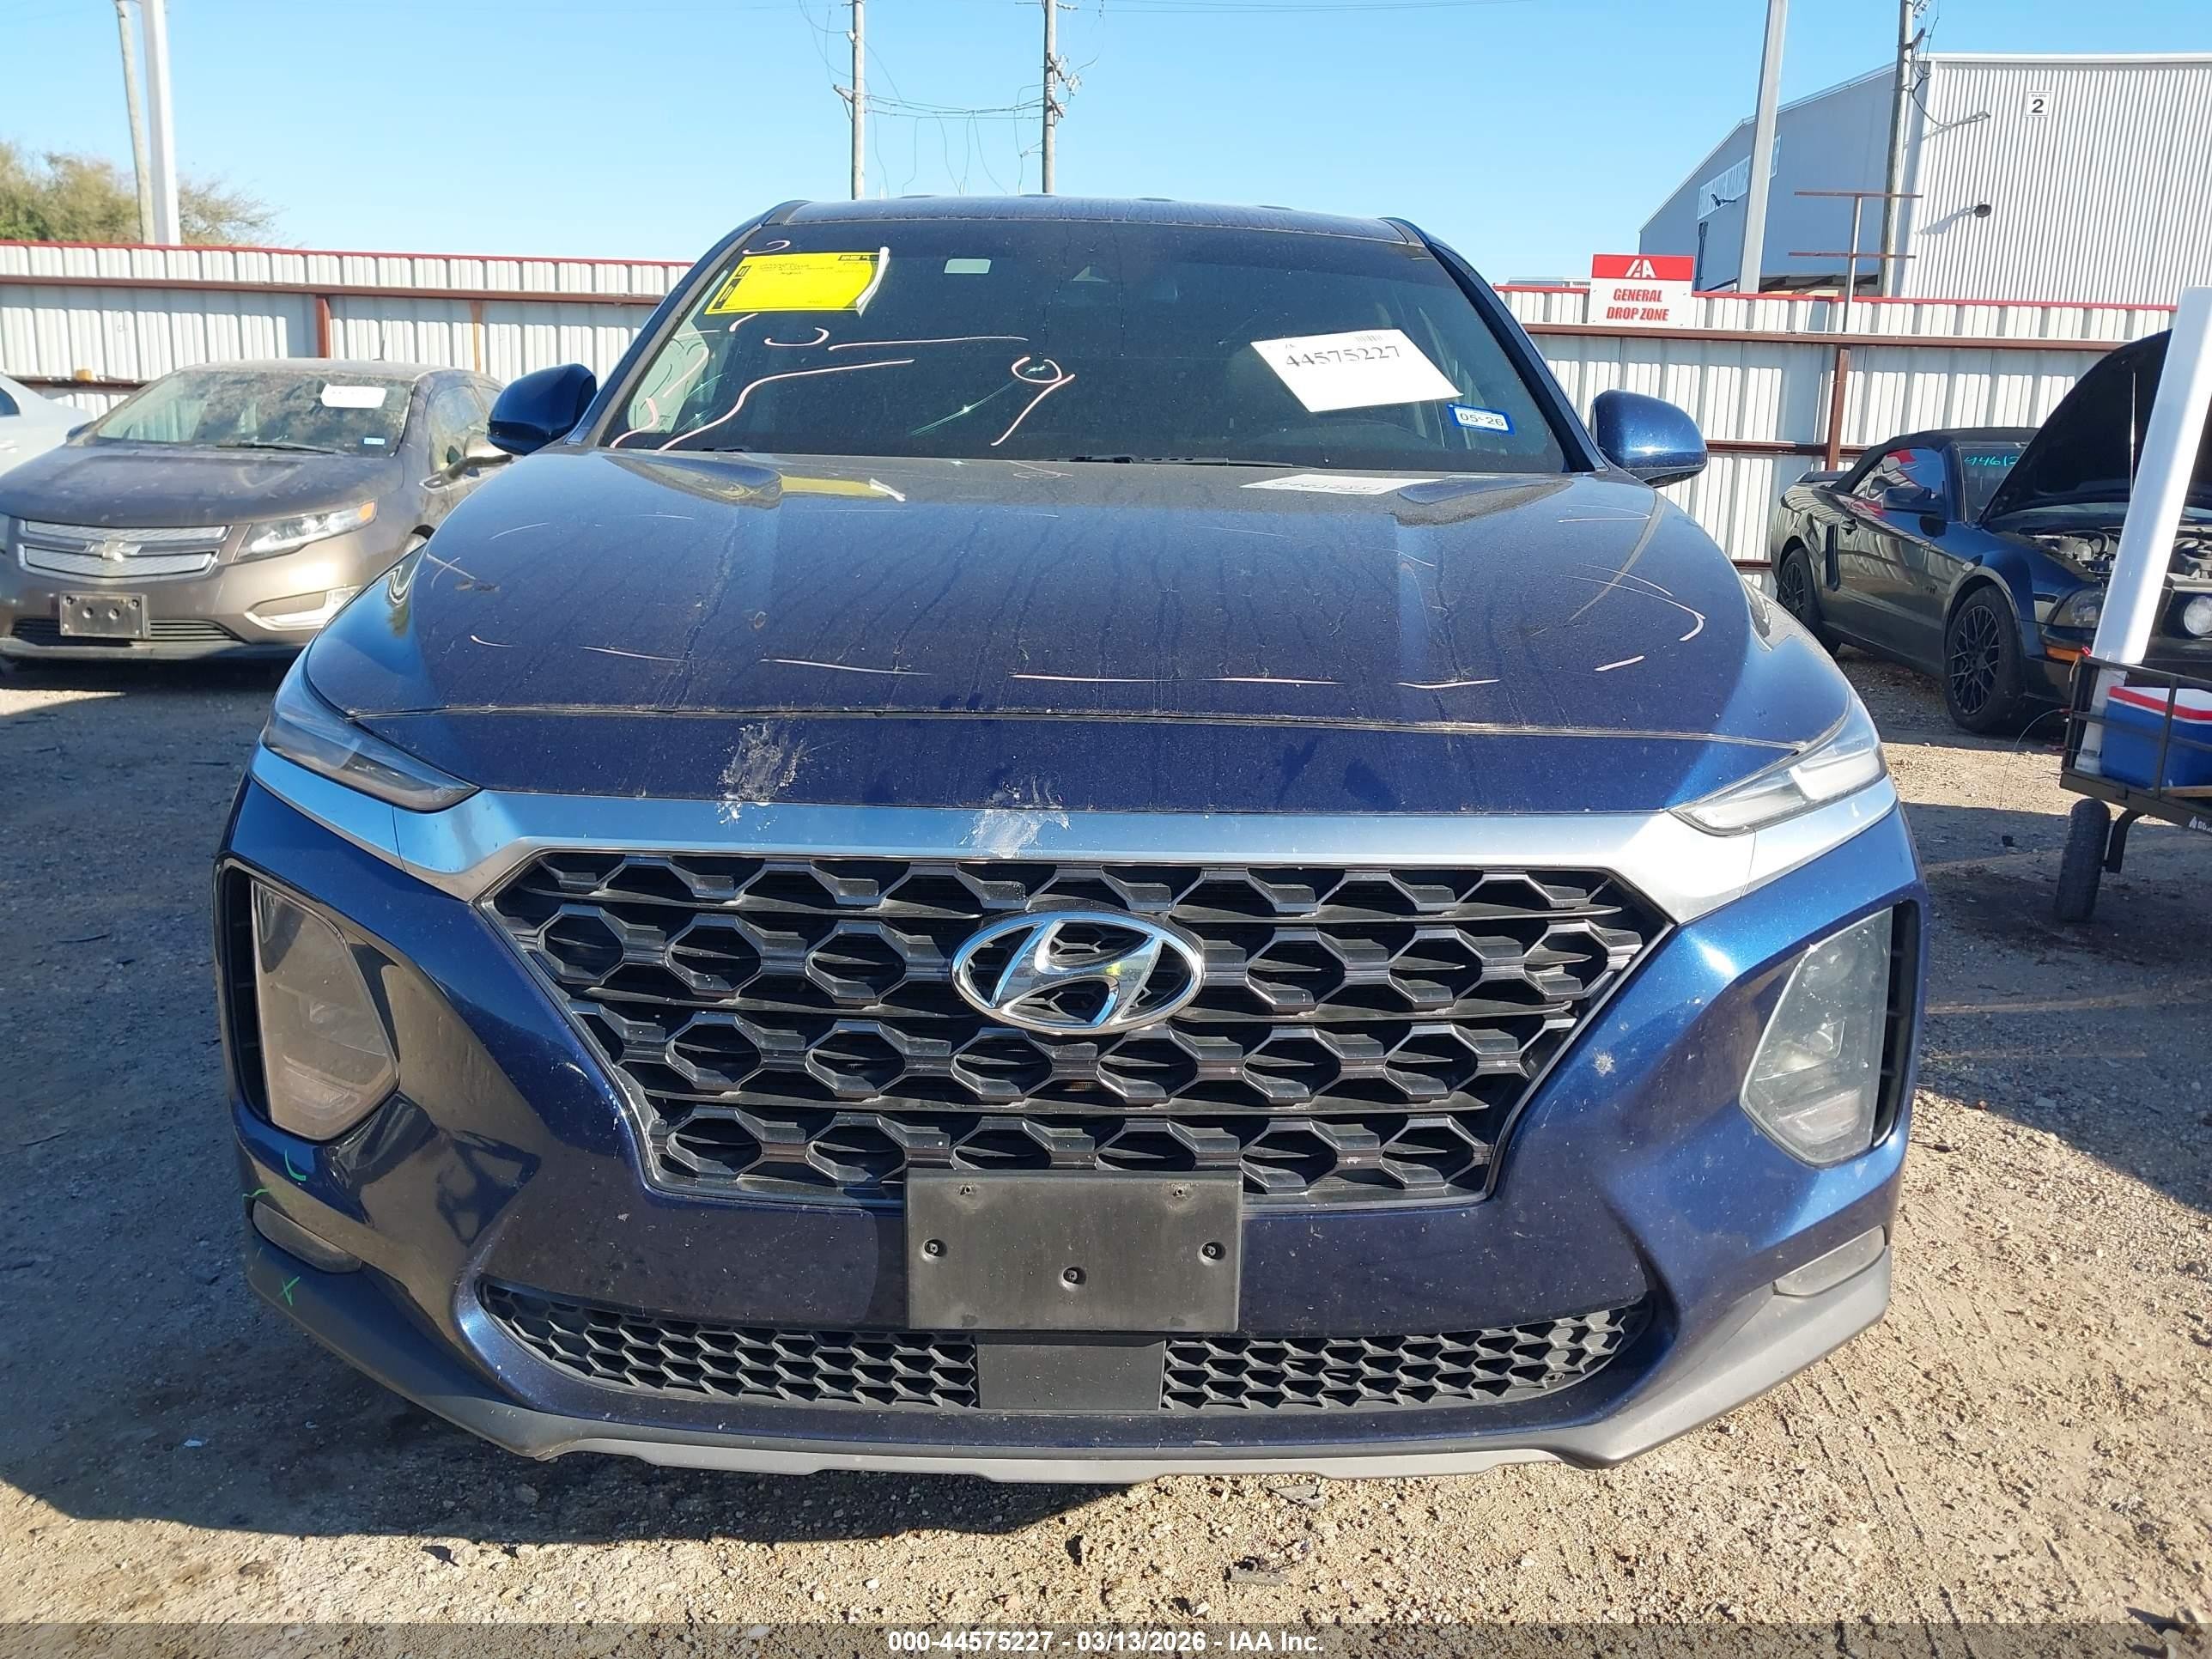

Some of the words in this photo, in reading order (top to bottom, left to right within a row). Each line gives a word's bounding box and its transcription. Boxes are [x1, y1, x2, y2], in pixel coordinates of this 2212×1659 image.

[2032, 99, 2044, 113] 2
[1613, 288, 1662, 302] GENERAL
[1606, 307, 1639, 320] DROP
[1641, 307, 1669, 321] ZONE
[1286, 345, 1401, 367] 44575227
